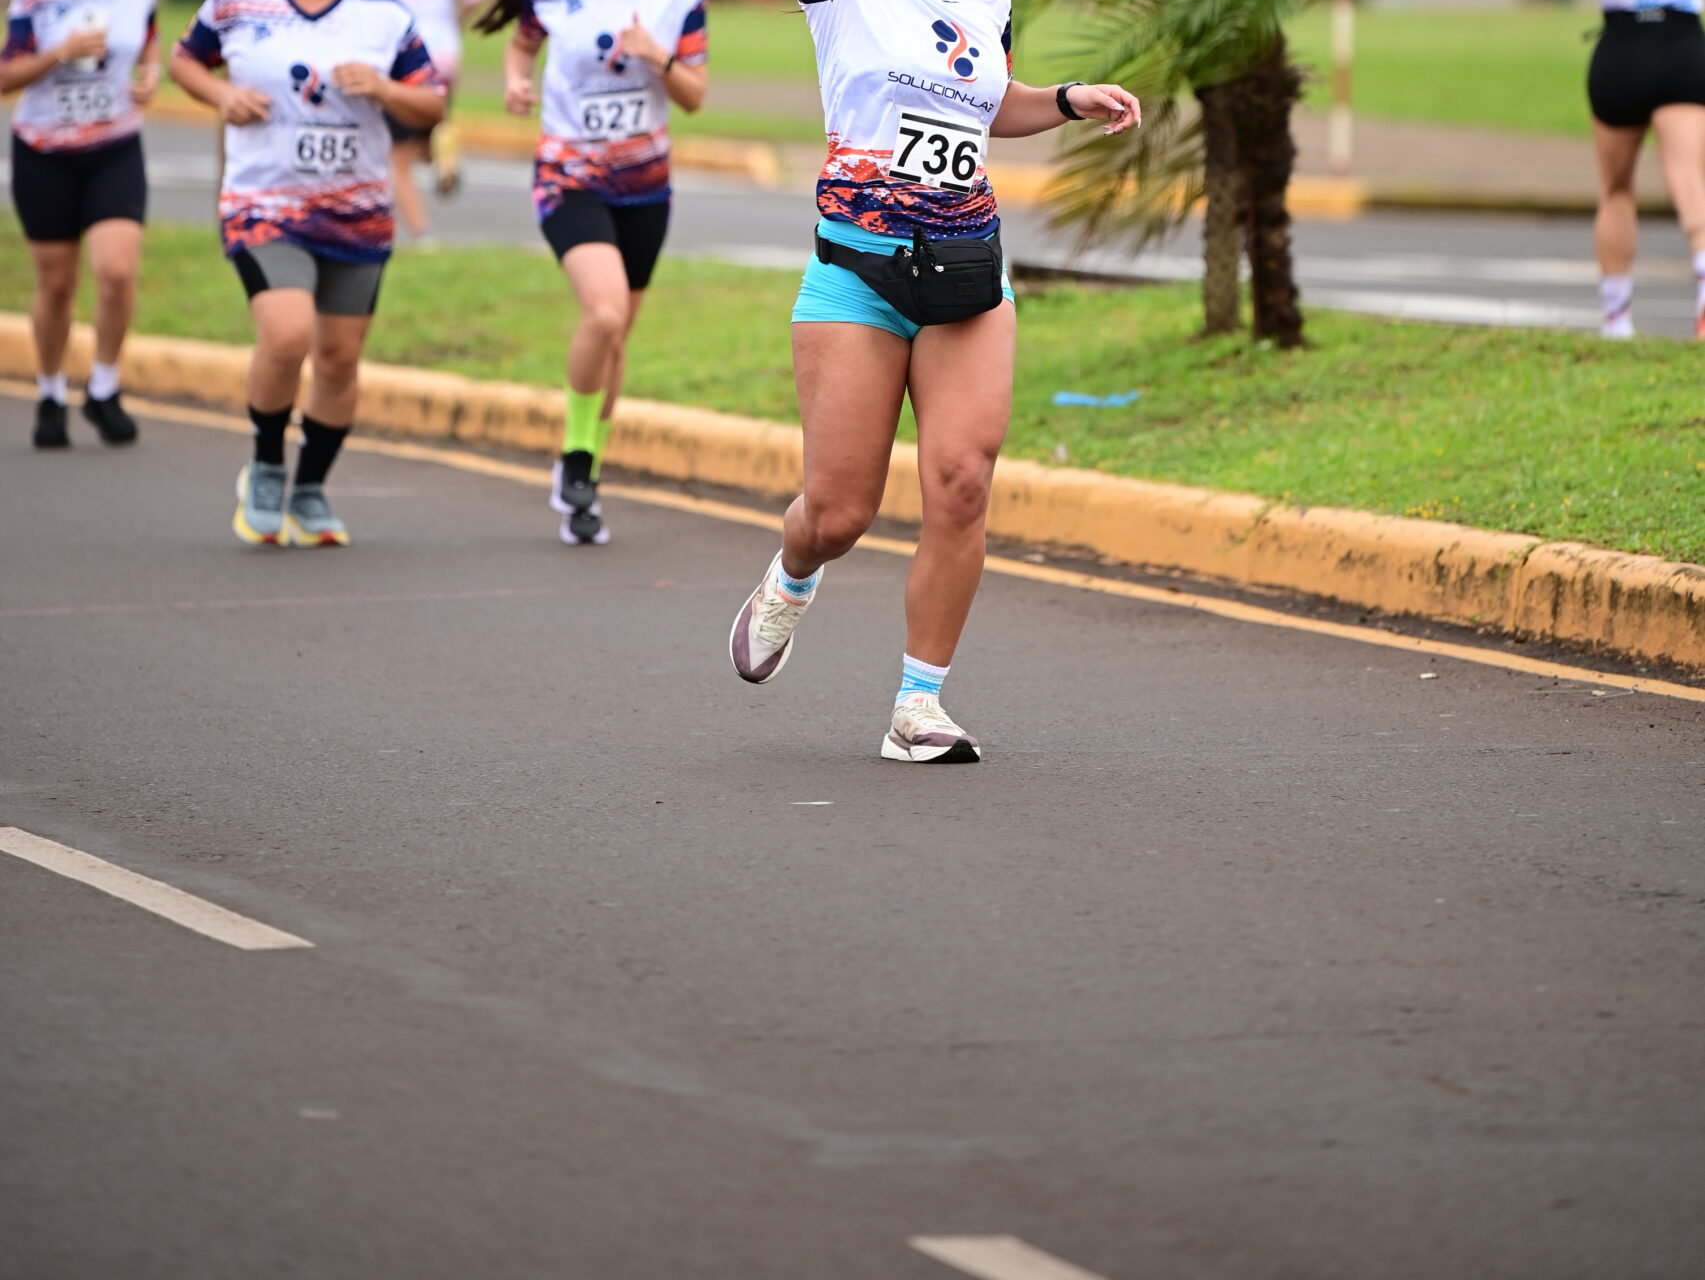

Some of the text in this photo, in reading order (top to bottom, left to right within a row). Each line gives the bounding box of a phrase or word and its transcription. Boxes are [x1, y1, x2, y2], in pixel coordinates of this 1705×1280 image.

[584, 100, 644, 132] 627
[298, 133, 358, 163] 685
[897, 127, 978, 181] 736
